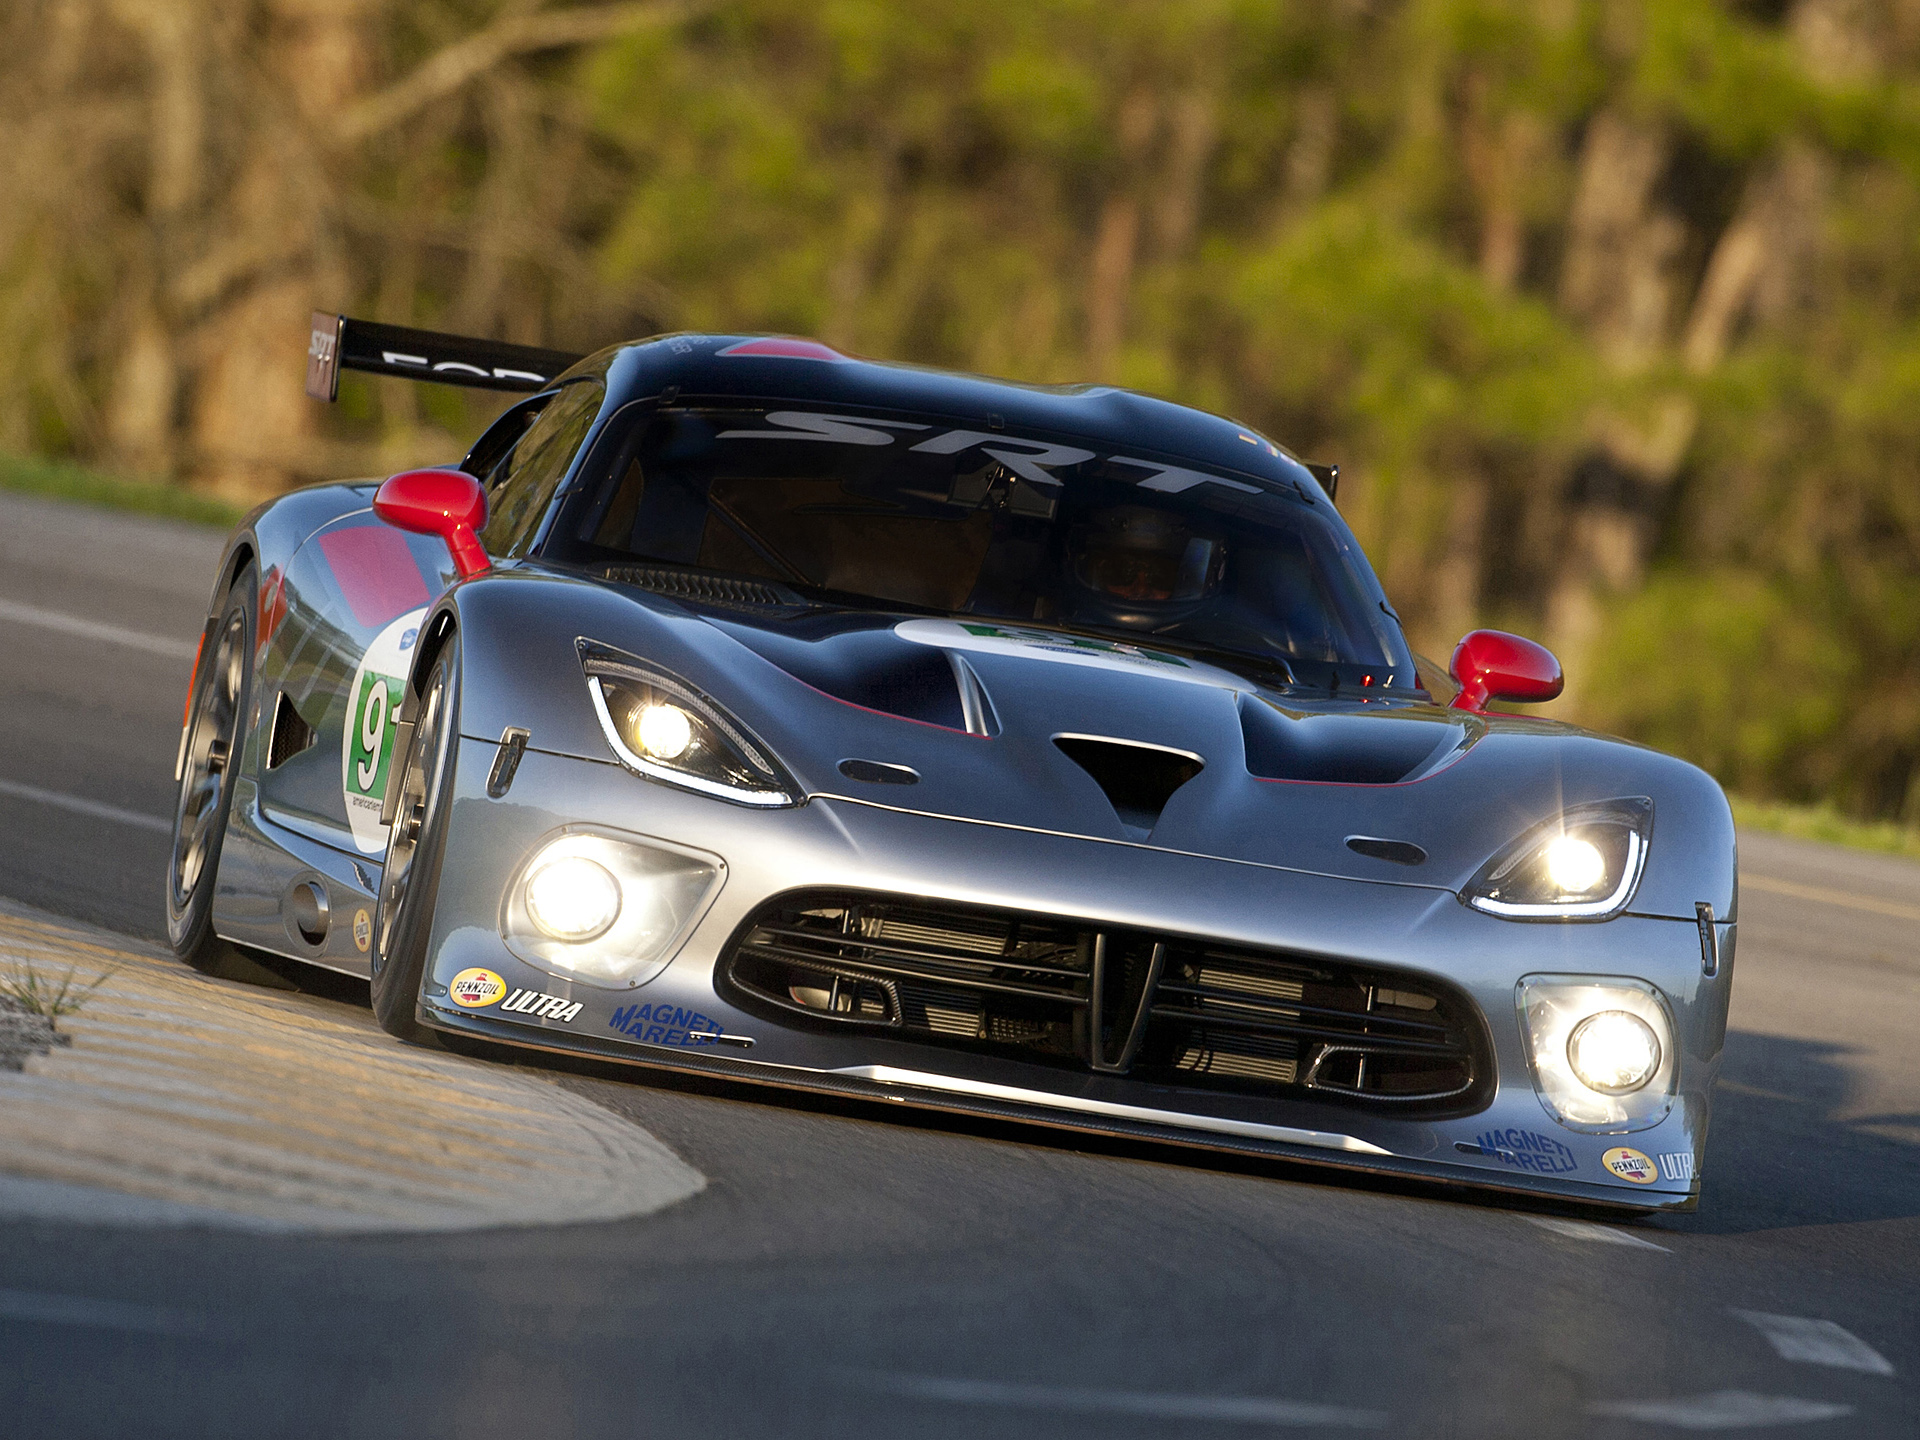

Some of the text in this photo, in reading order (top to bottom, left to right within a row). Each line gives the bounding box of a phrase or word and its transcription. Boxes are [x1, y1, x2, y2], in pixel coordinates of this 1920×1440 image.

[715, 411, 1264, 494] SRT
[453, 977, 584, 1023] PENNZOIL ULTRA
[609, 1003, 724, 1036] MAGNETI
[1476, 1129, 1577, 1160] MAGNETI
[1610, 1158, 1651, 1173] PENNZOIL
